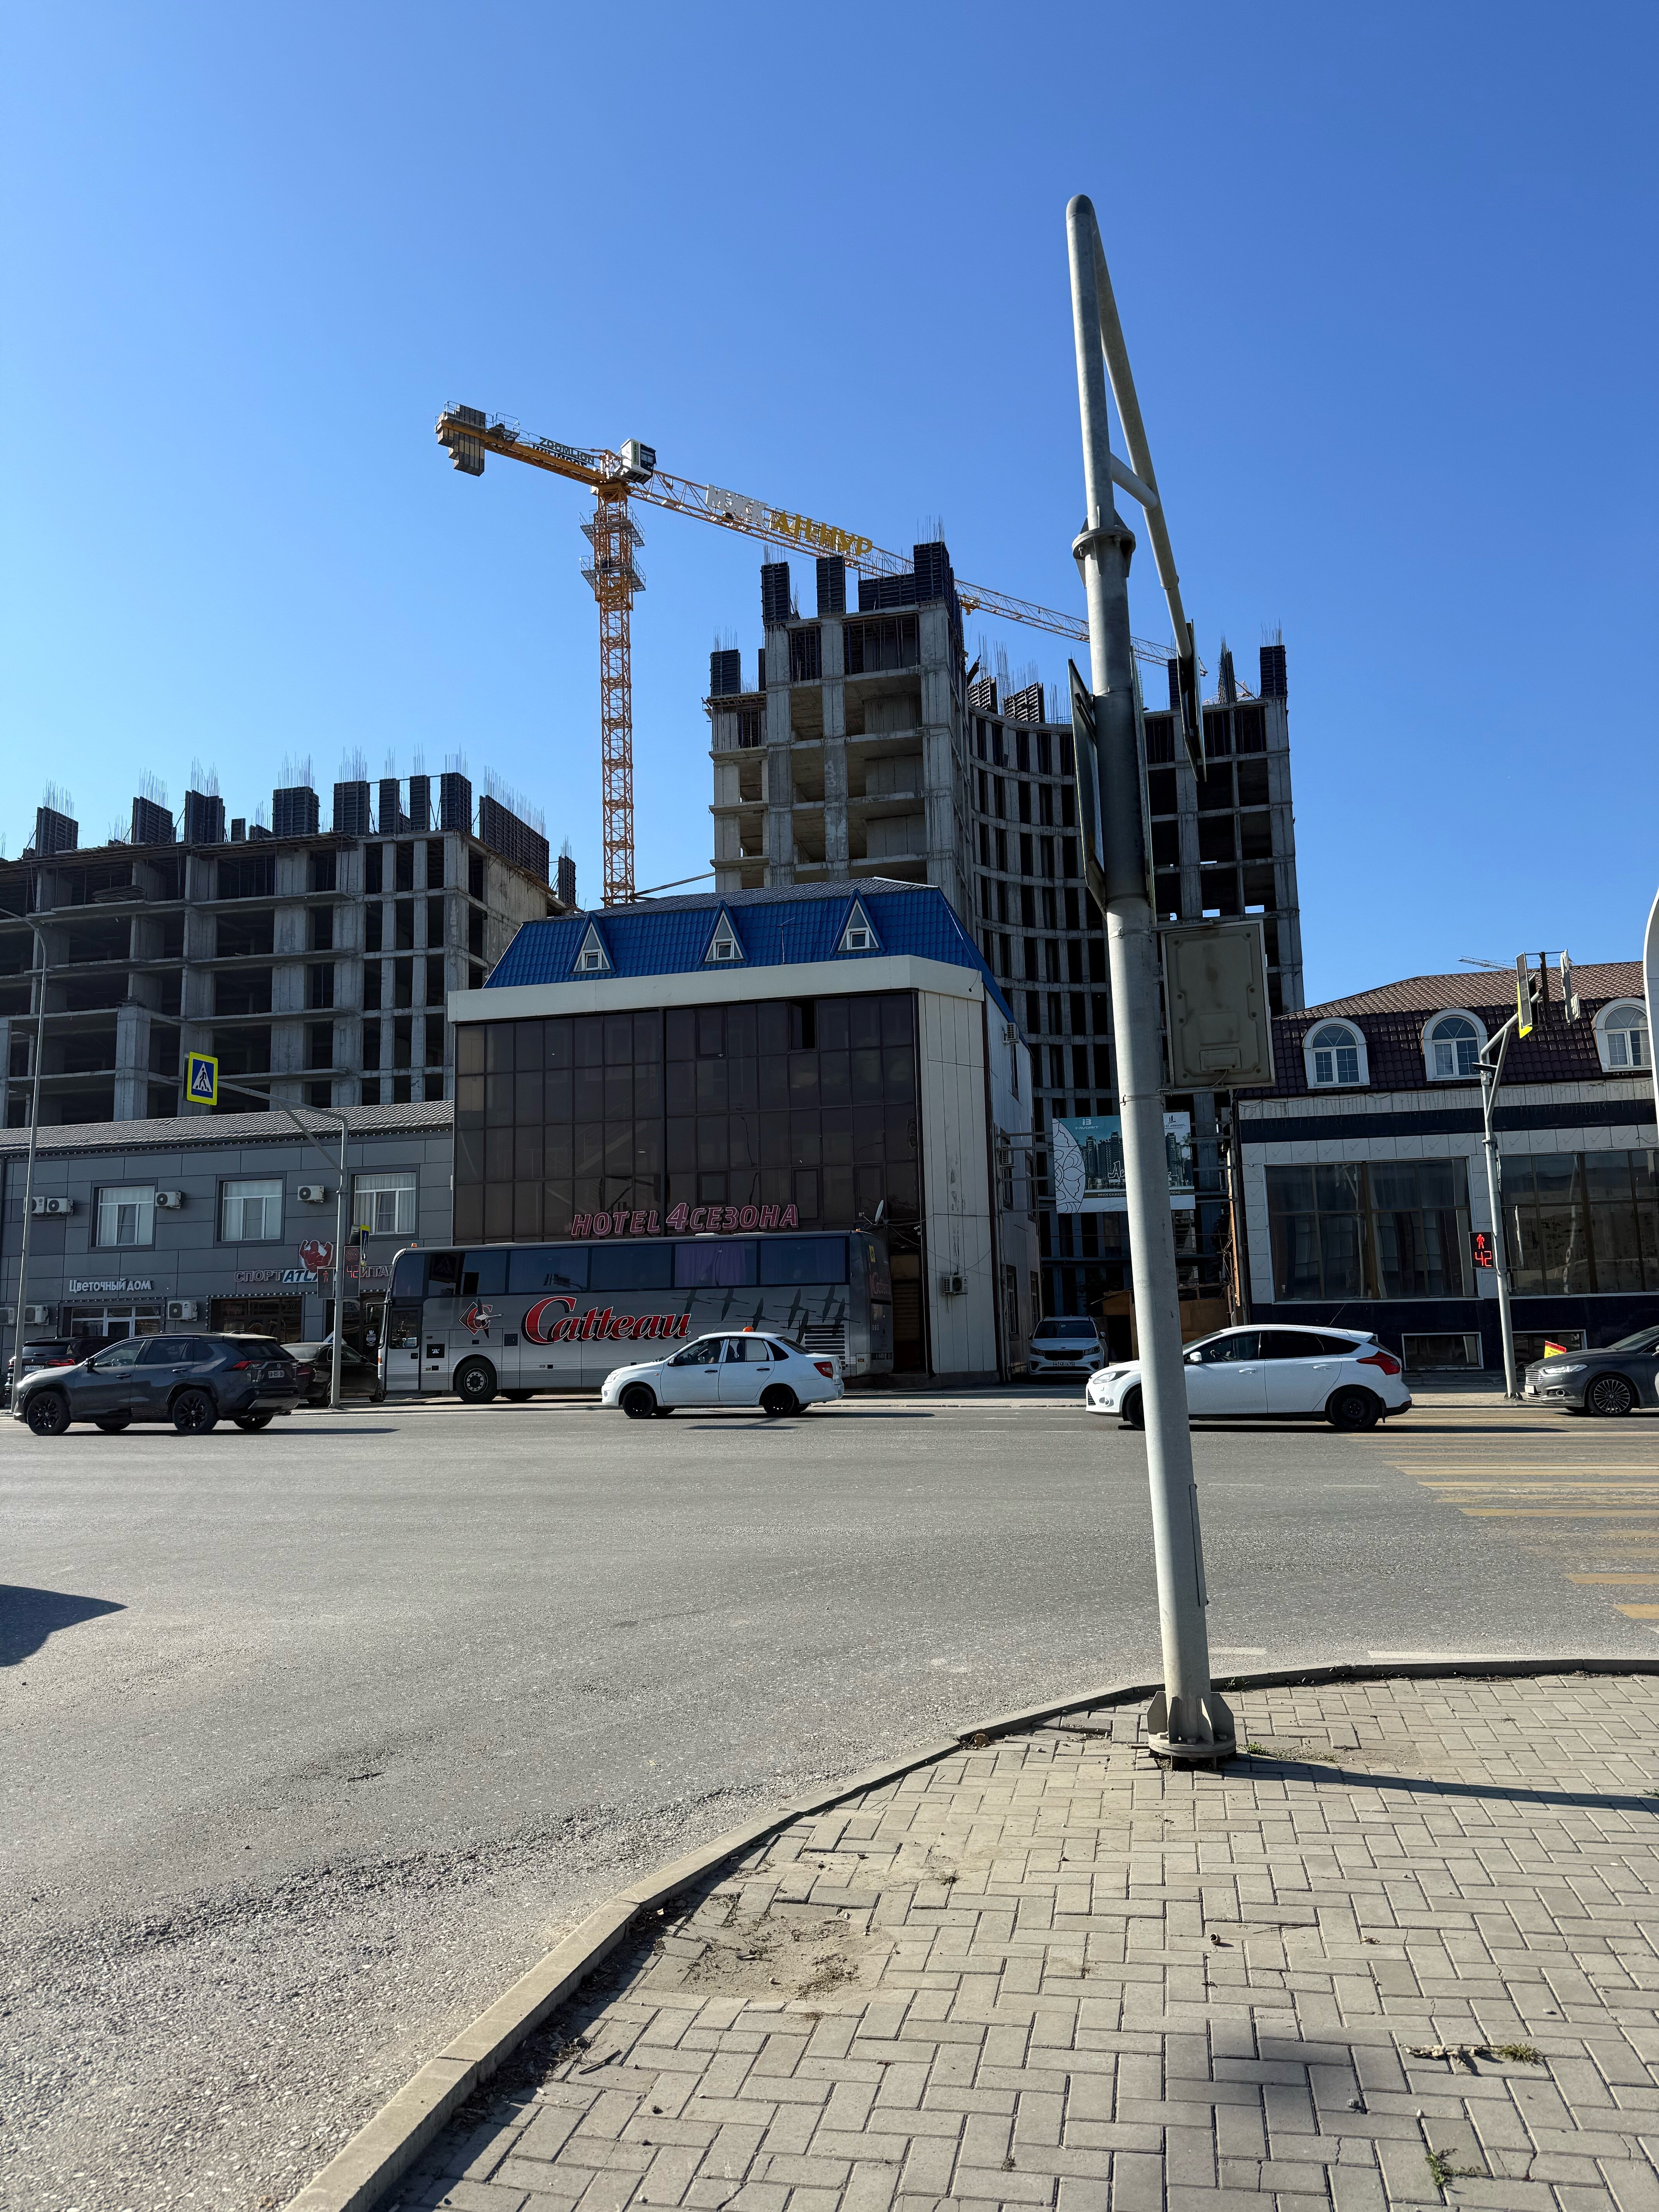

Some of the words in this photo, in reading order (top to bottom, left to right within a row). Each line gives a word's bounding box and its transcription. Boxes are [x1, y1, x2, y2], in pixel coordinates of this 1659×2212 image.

[706, 484, 768, 526] МЖК
[775, 511, 873, 556] АН-НУР
[571, 1210, 661, 1238] HOTEL
[666, 1202, 689, 1232] 4
[690, 1204, 799, 1232] СЕЗОНА
[1475, 1251, 1492, 1267] 42
[235, 1270, 283, 1282] СПОРТ
[347, 1265, 359, 1278] 42
[69, 1278, 127, 1293] Цветочный
[522, 1296, 692, 1346] Catteau
